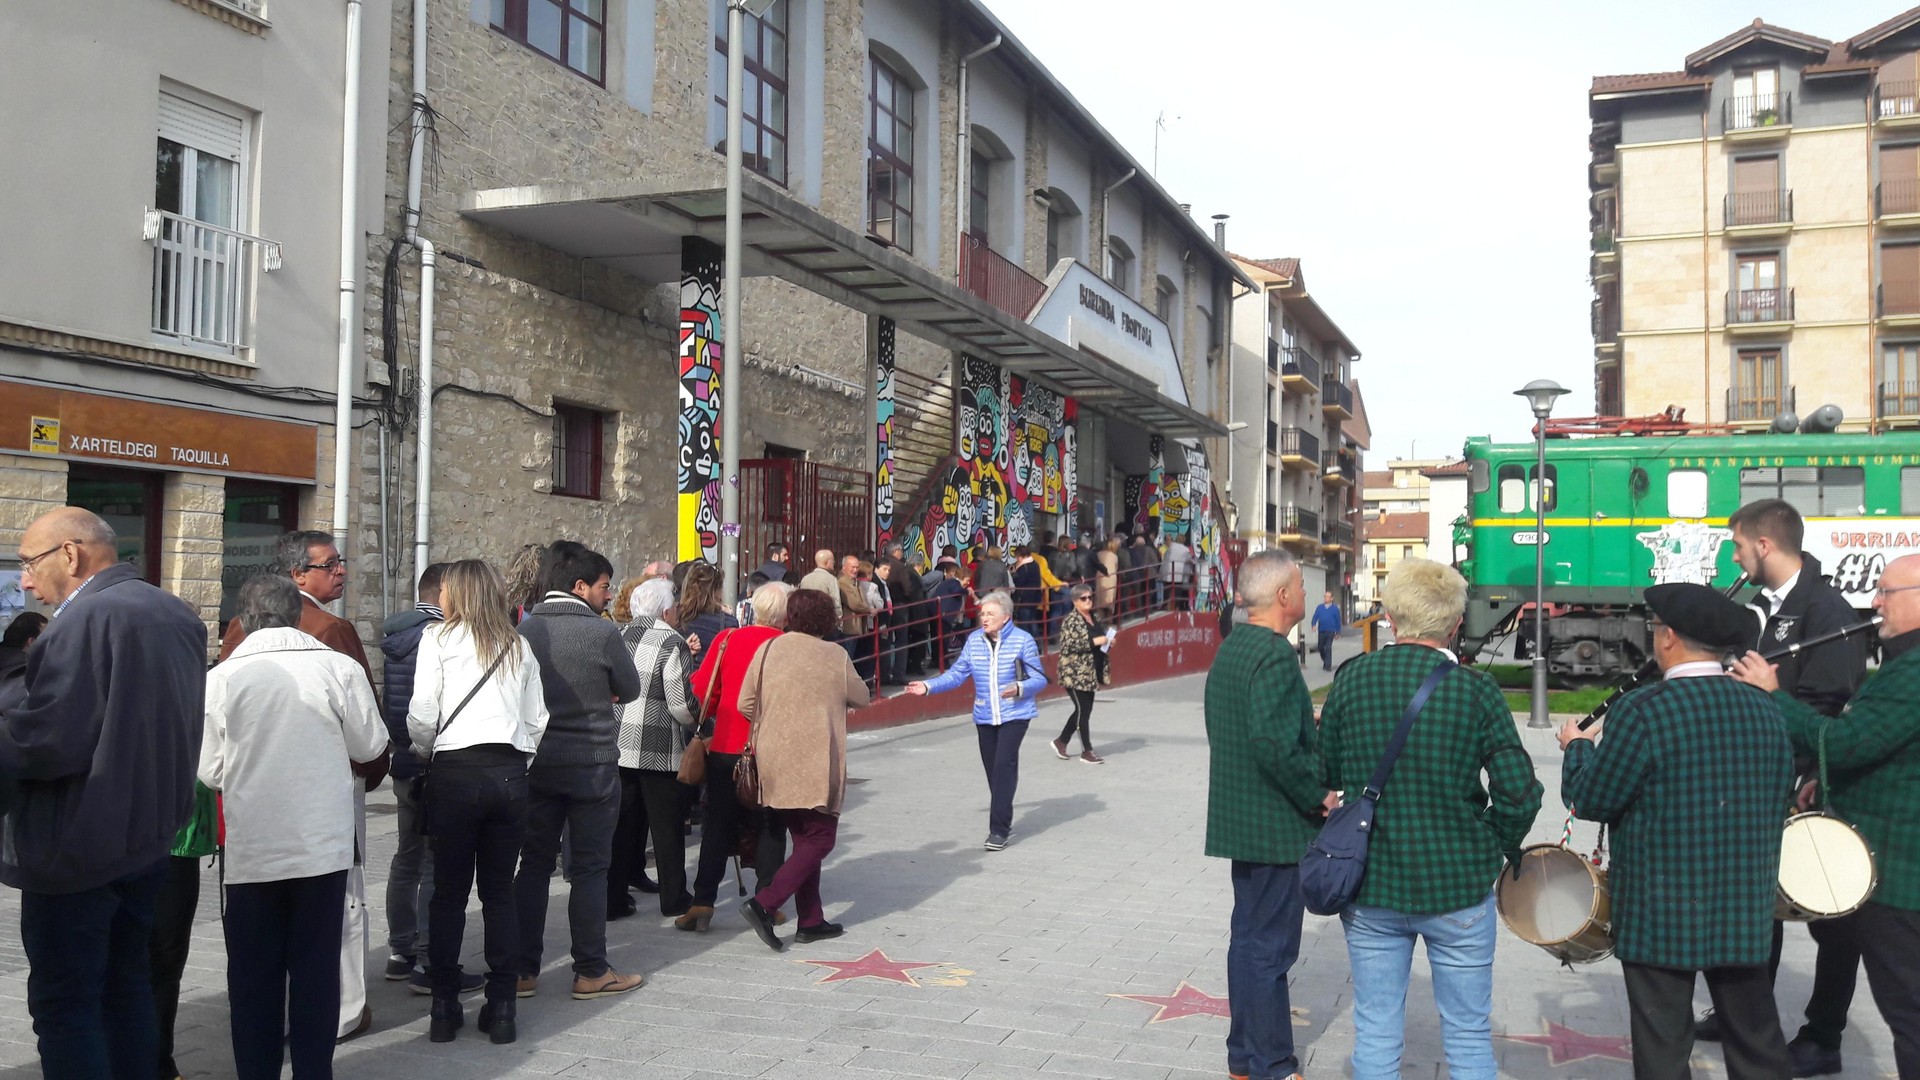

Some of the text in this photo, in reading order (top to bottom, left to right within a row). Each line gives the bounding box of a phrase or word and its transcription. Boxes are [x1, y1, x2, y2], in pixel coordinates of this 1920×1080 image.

[70, 435, 230, 466] XARTELDEGI TAQUILLA
[1668, 456, 1784, 468] SAKANAKO
